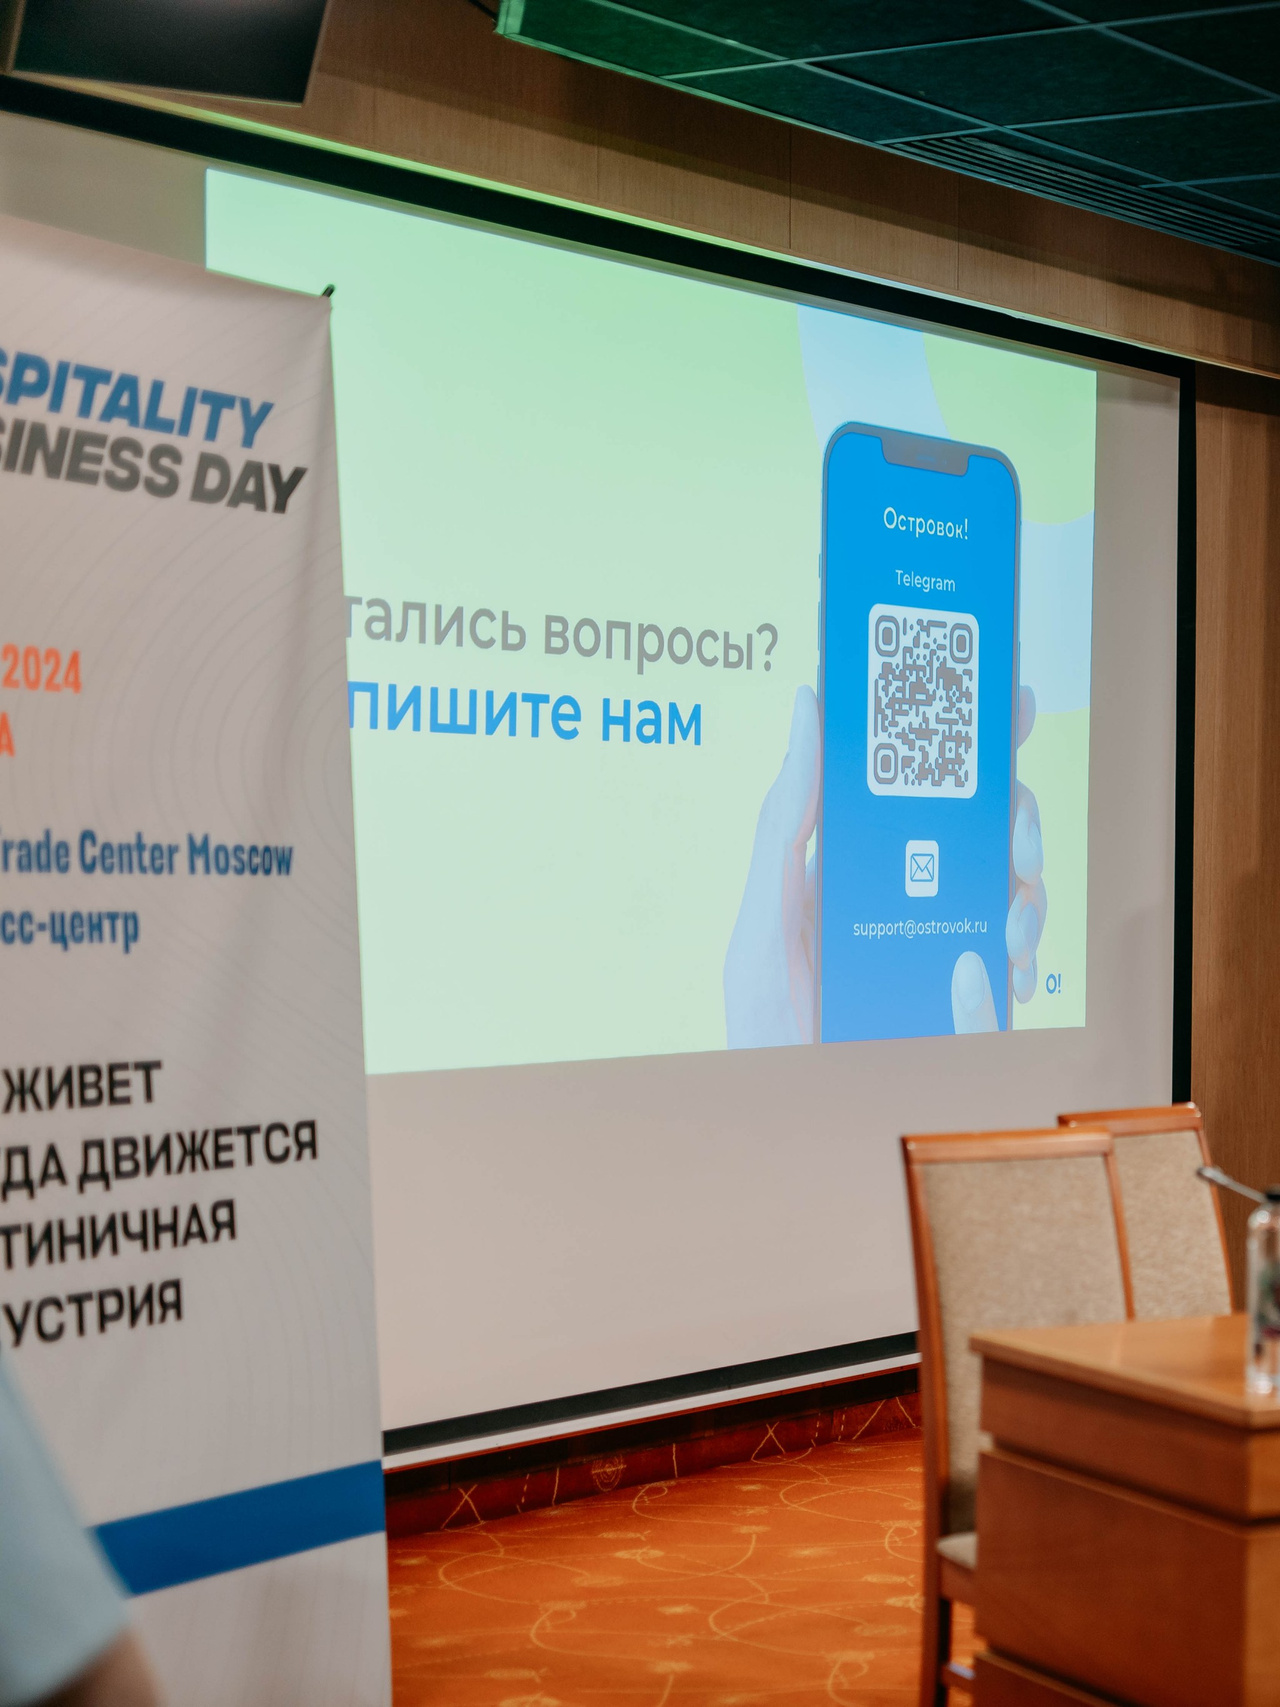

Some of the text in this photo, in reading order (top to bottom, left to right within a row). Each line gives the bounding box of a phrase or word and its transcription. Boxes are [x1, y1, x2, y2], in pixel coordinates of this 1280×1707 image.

[0, 346, 275, 449] PITALITY
[0, 417, 308, 515] INESS DAY
[883, 506, 969, 540] Островок!
[895, 569, 956, 593] Telegram
[544, 614, 779, 675] вопросы?
[347, 681, 701, 746] пишите нам
[0, 829, 293, 877] rade Center Moscow
[853, 918, 988, 939] support@ostrovok.ru
[1, 1060, 162, 1114] ЖИВЕТ
[77, 1120, 318, 1194] ДВИЖЕТСЯ
[0, 1198, 236, 1270] ТИНИЧНАЯ
[2, 1278, 182, 1348] УСТРИЯ
